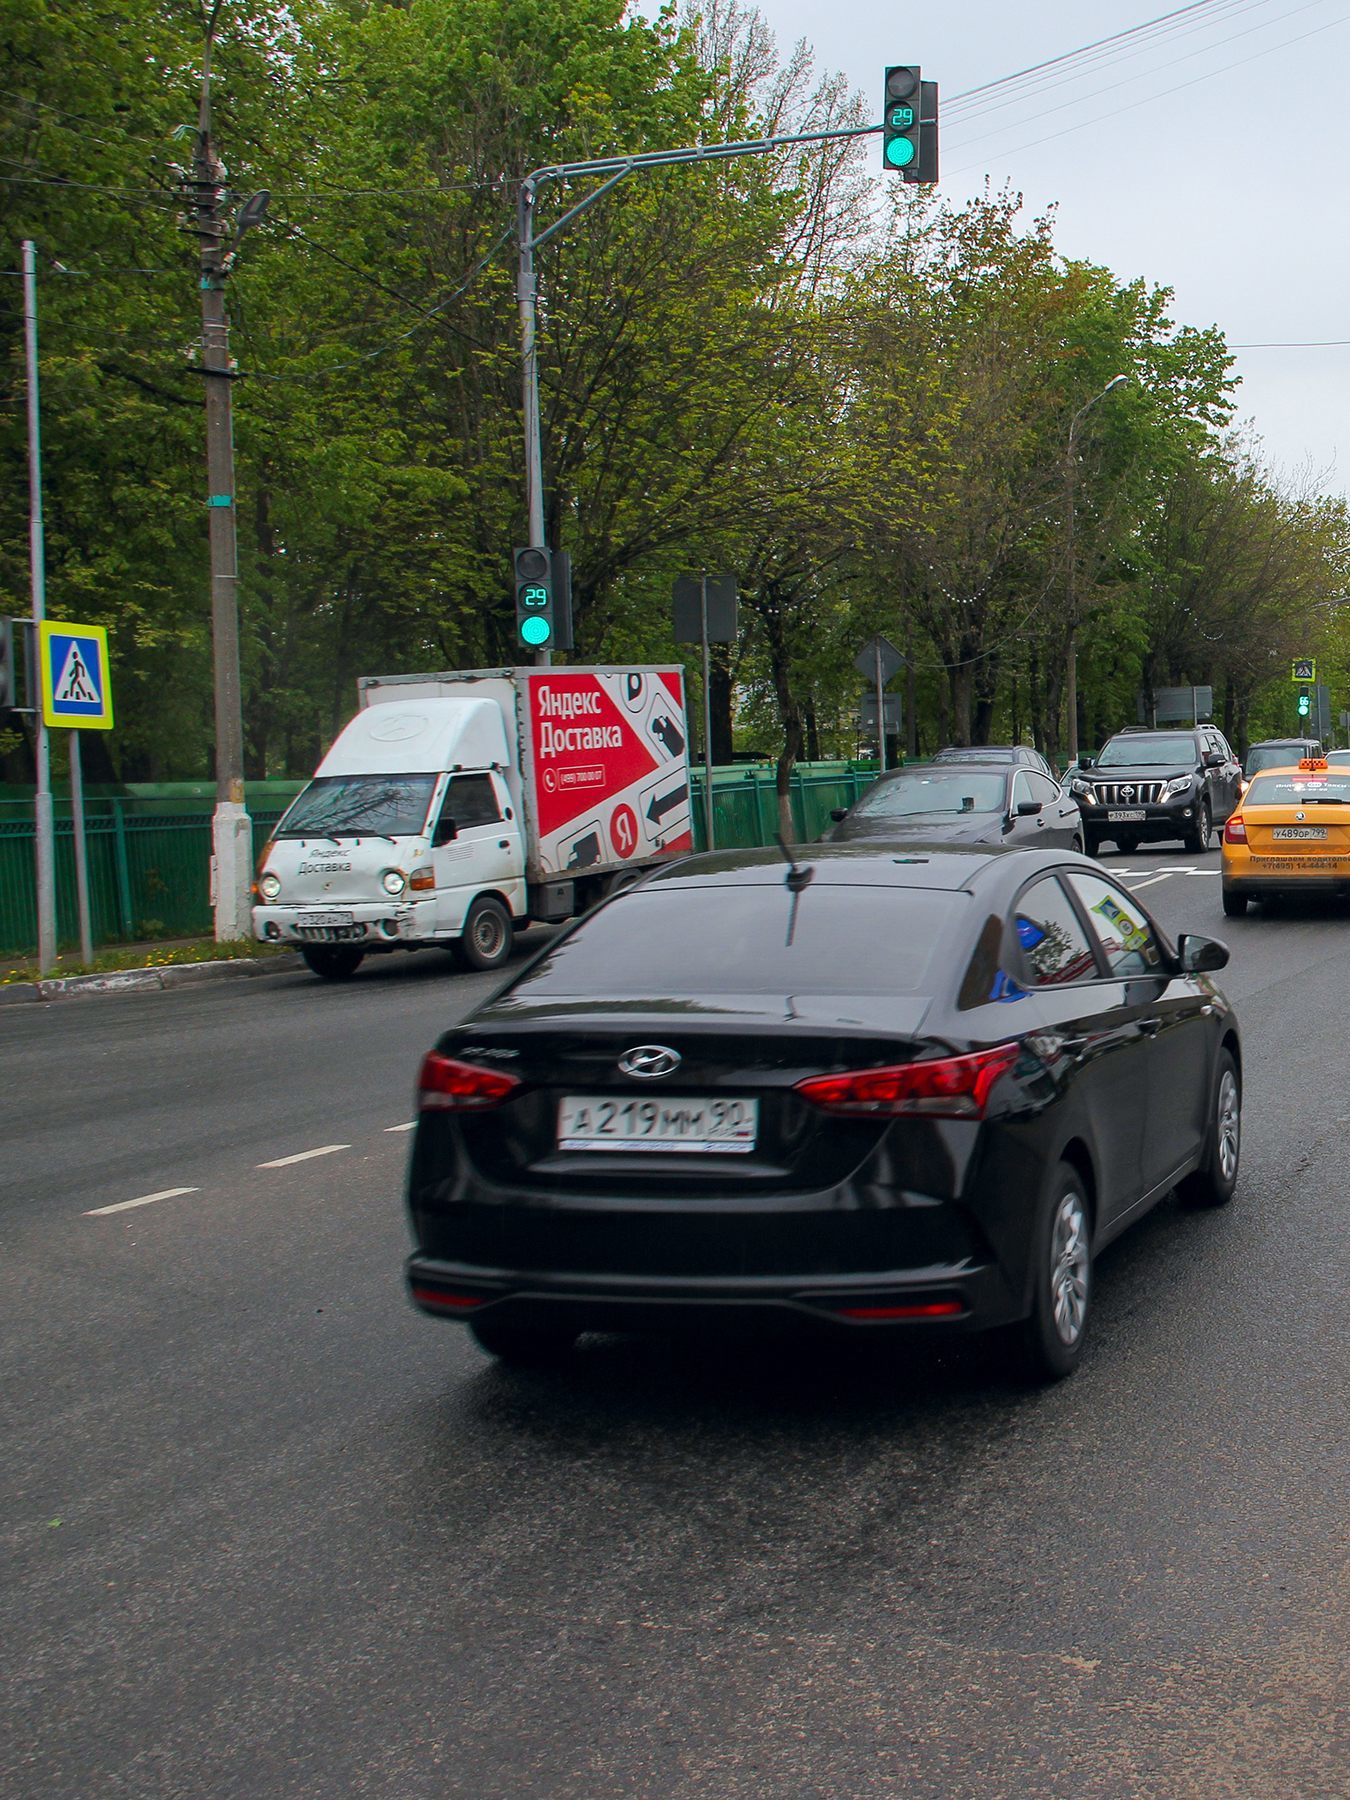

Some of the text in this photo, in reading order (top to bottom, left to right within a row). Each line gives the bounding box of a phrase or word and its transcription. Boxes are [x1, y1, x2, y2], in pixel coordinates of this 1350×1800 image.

[892, 108, 913, 126] 29
[525, 588, 547, 606] 29
[538, 685, 602, 719] Яндекс
[540, 722, 622, 759] Доставка
[616, 812, 633, 851] Я
[298, 861, 352, 876] Доставка
[1250, 855, 1305, 864] Приглашаем
